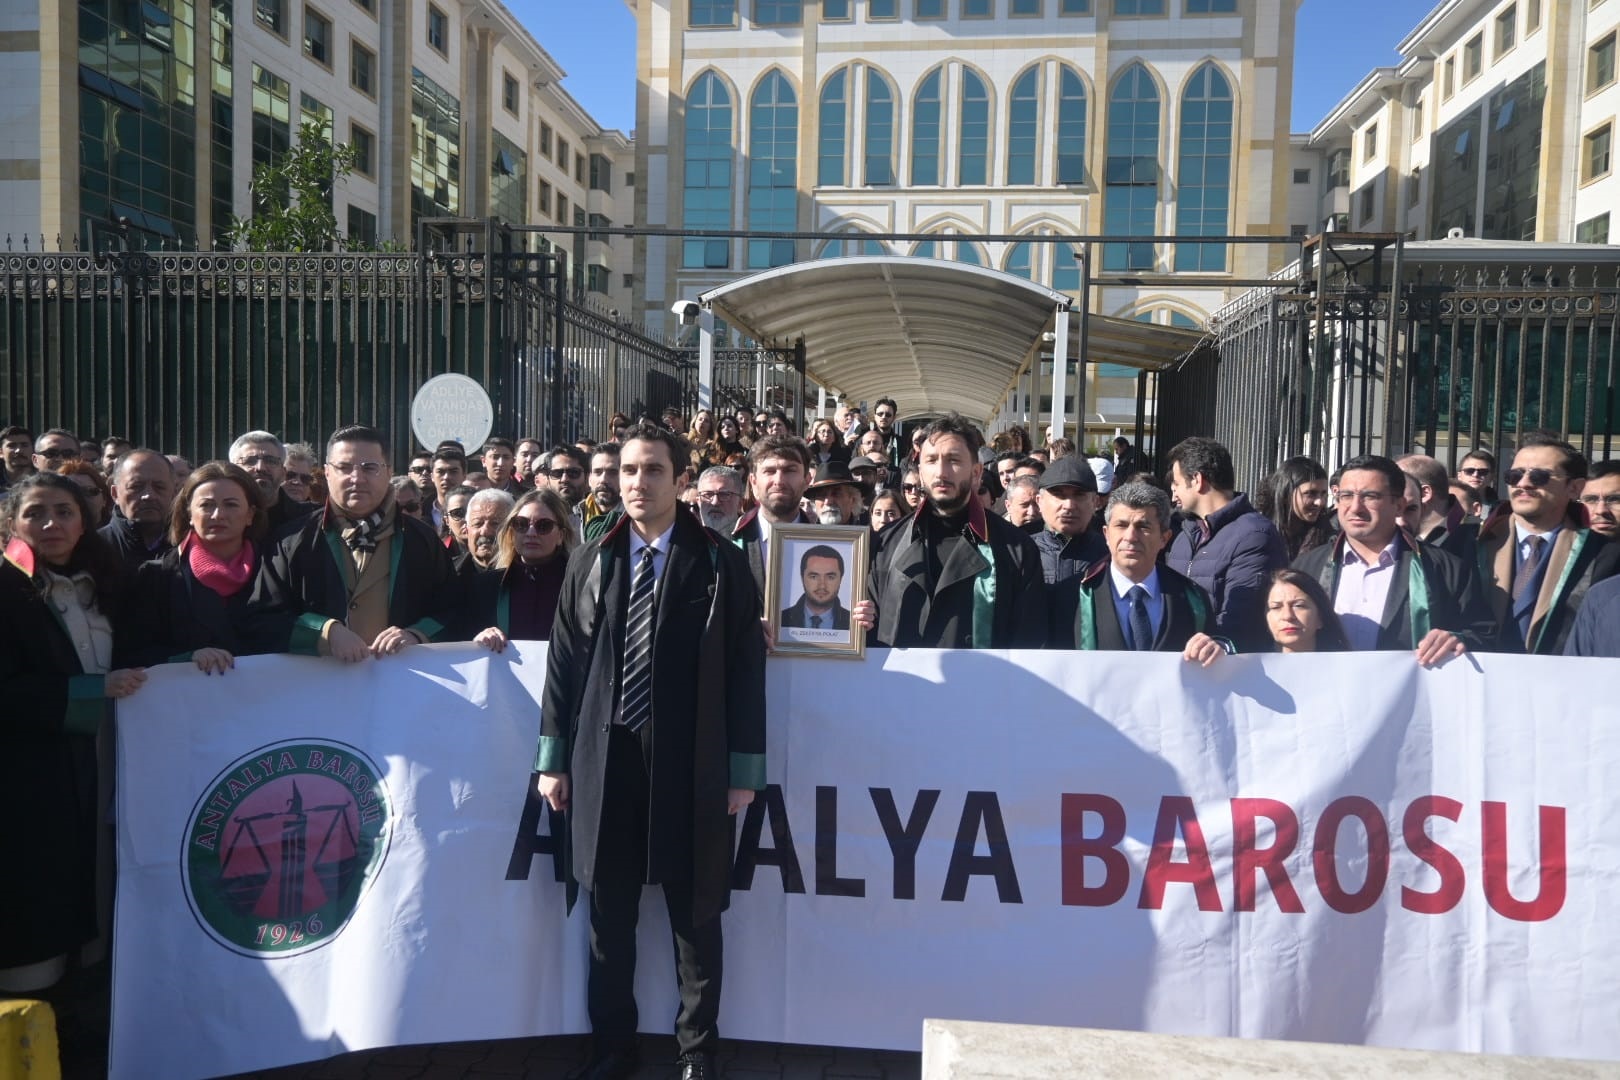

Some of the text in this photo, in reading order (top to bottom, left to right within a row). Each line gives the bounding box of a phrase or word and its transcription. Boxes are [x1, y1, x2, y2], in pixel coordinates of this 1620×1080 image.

[196, 750, 380, 850] ANTALYA BAROSU
[505, 772, 1566, 922] AALYA BAROSU
[255, 913, 323, 945] 1926
